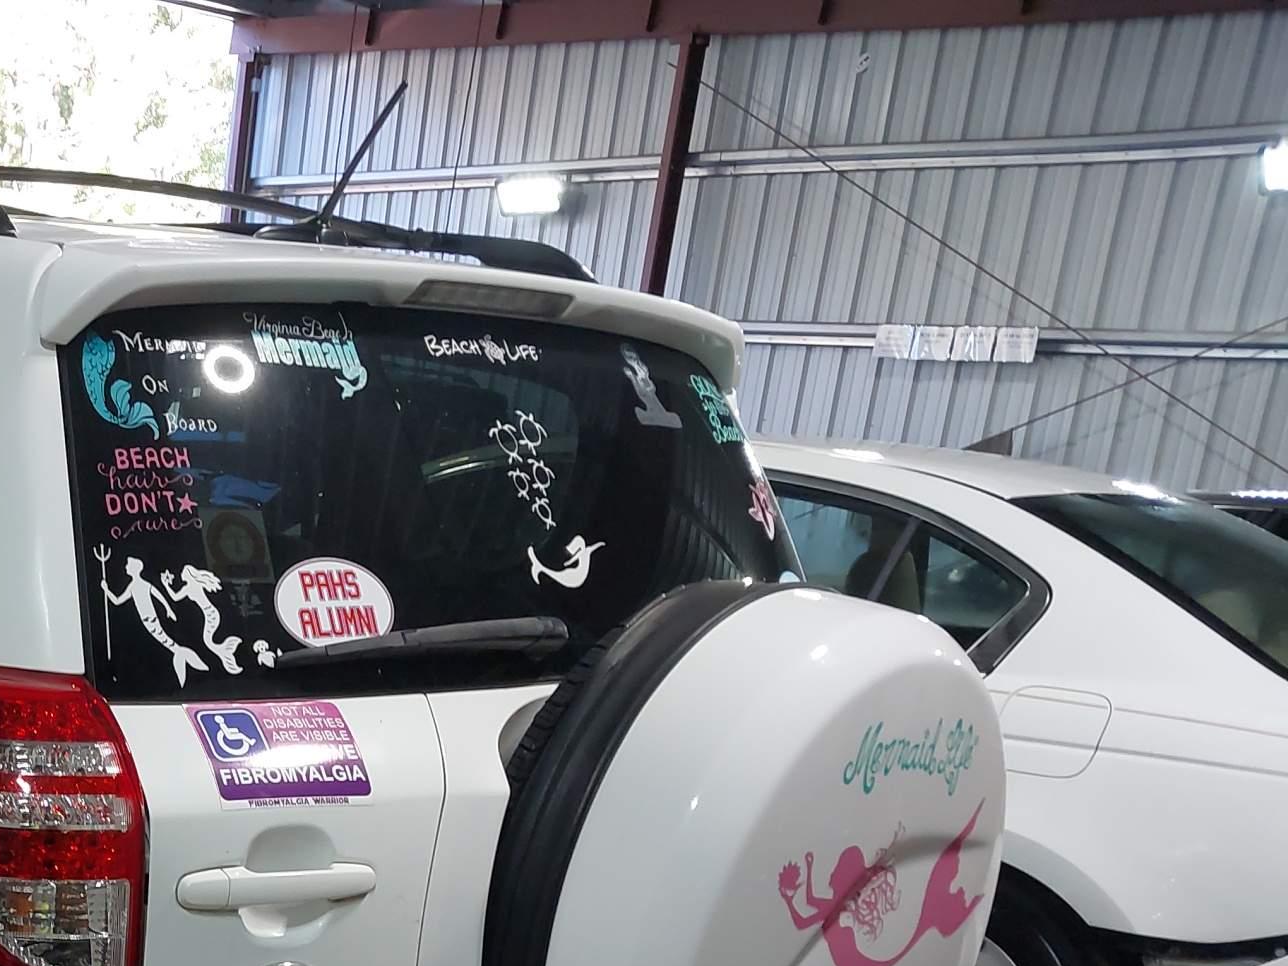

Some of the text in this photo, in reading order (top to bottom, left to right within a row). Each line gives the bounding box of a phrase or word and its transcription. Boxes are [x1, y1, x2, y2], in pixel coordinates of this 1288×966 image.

[243, 312, 353, 340] Virginia Beach
[251, 329, 366, 381] Mermaid
[424, 334, 482, 357] BEACH
[114, 447, 190, 470] BEACH
[97, 462, 193, 490] hair
[105, 491, 175, 516] DON'T
[298, 568, 361, 601] PAHS
[297, 605, 379, 640] ALUMNI
[262, 717, 346, 730] DISABILITIES
[271, 706, 326, 717] NOT ALL
[272, 729, 351, 742] ARE VISIBLE
[219, 764, 366, 787] FIBROMYALGIA
